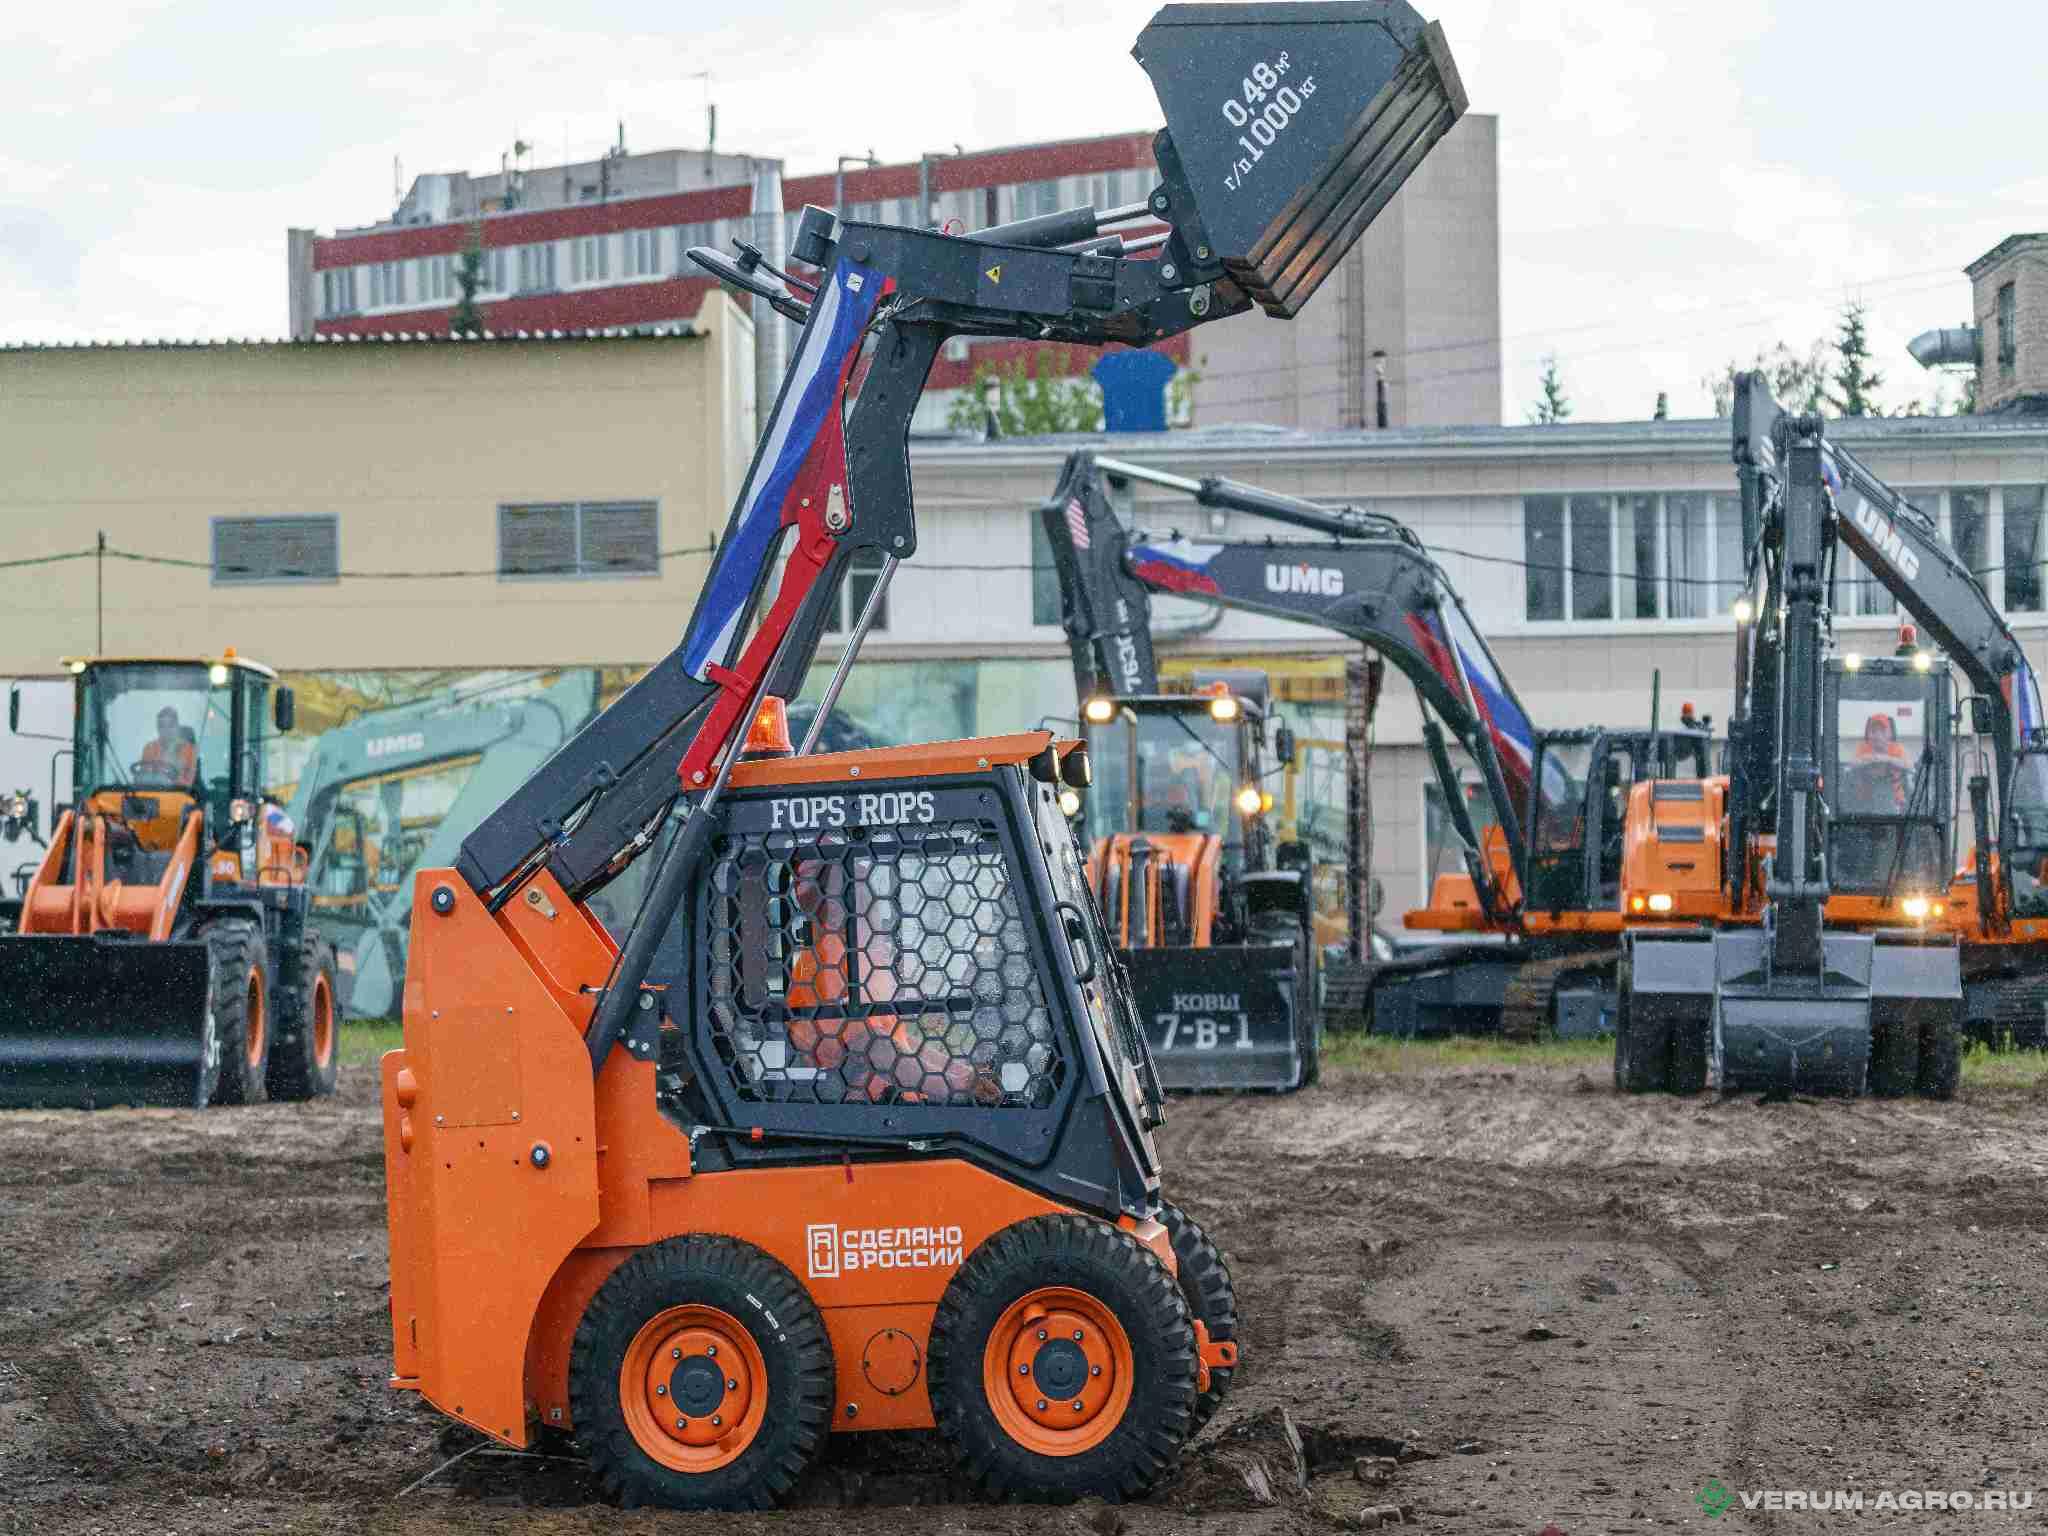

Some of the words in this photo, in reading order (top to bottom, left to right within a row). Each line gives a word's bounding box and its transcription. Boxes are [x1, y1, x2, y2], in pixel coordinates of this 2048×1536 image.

[1222, 62, 1278, 126] 0,48
[1239, 86, 1302, 162] 1000
[1299, 75, 1318, 99] кг
[1855, 497, 1921, 580] UMG
[1265, 562, 1344, 596] UMG
[770, 795, 847, 830] FOPS
[857, 791, 936, 826] ROPS
[843, 1225, 964, 1250] СДЕЛАНО
